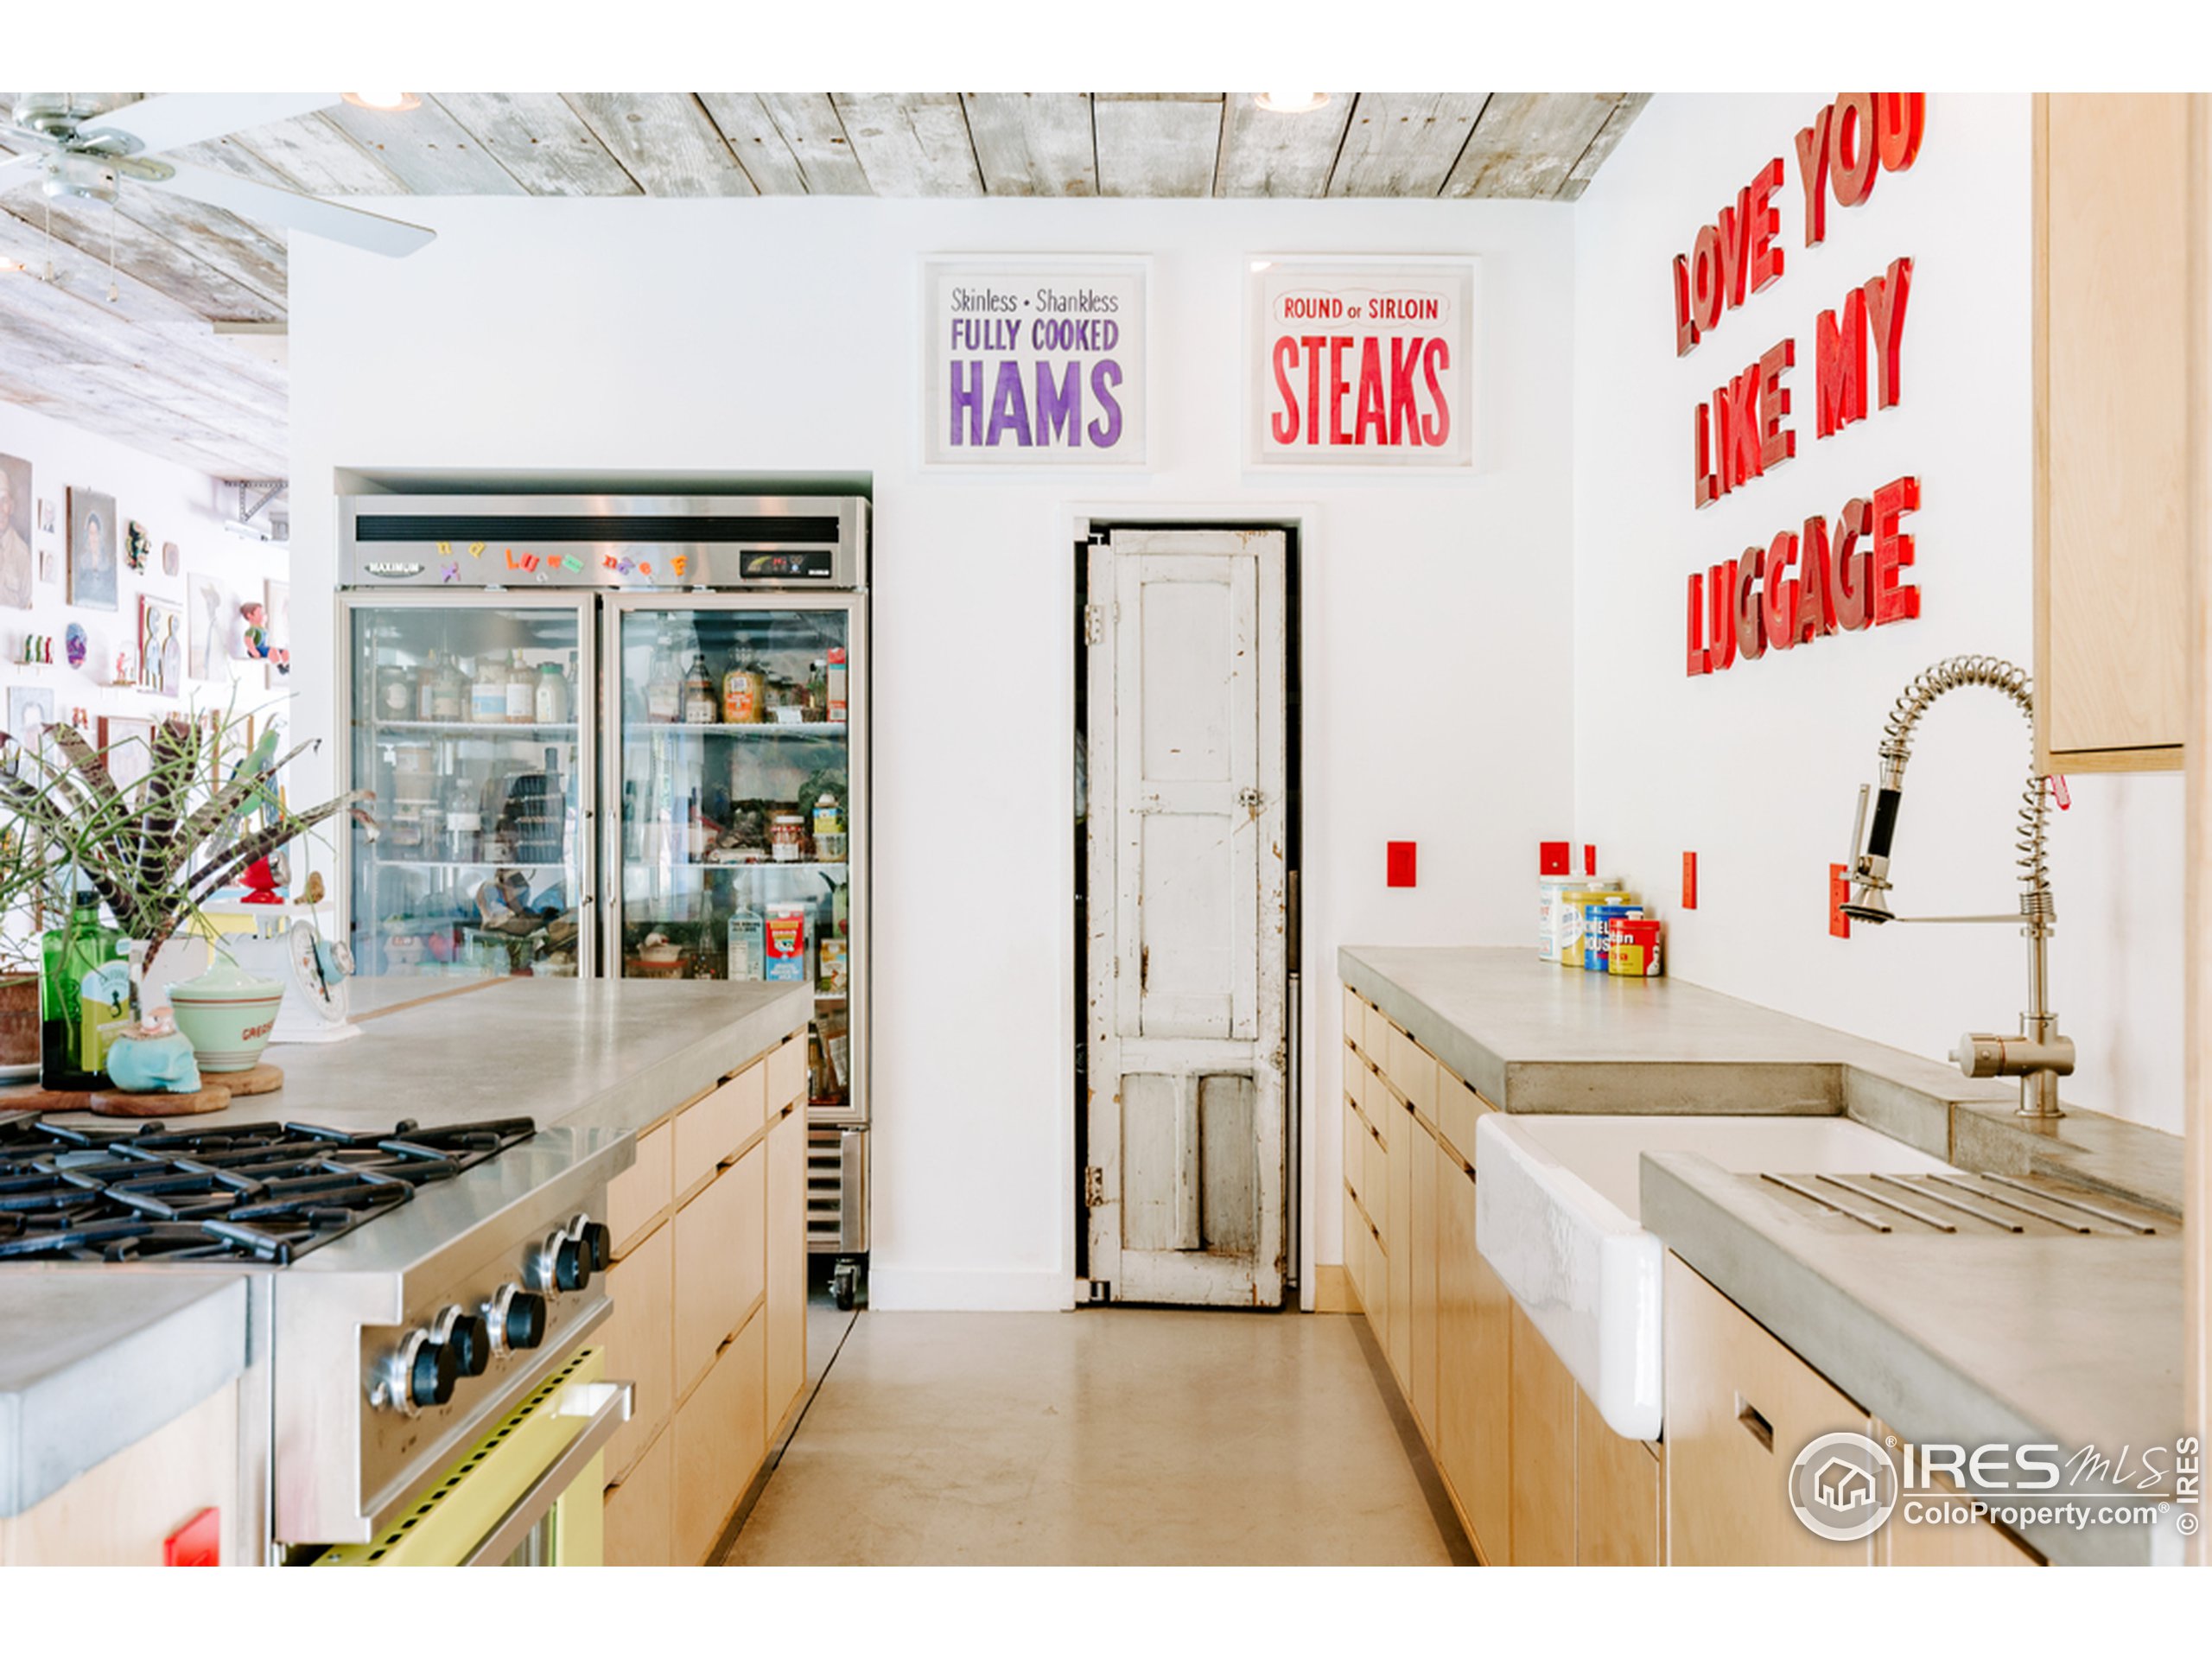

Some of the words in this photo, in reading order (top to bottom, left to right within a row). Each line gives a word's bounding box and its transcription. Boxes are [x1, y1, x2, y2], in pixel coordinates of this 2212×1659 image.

[1673, 156, 1785, 358] LOVE
[1795, 92, 1926, 249] YOU
[950, 288, 1018, 312] Skinless
[1035, 289, 1119, 312] Shankless
[951, 318, 1022, 351] FULLY
[1032, 318, 1119, 351] COOKED
[1284, 297, 1343, 319] ROUND
[1347, 306, 1362, 319] or
[1368, 298, 1439, 320] SIRLOIN
[950, 359, 1122, 448] HAMS
[1271, 335, 1451, 447] STEAKS
[1694, 338, 1795, 510] LIKE
[1816, 256, 1915, 440] MY
[368, 562, 420, 573] MAXIMUM
[1687, 475, 1921, 677] LUGGAGE
